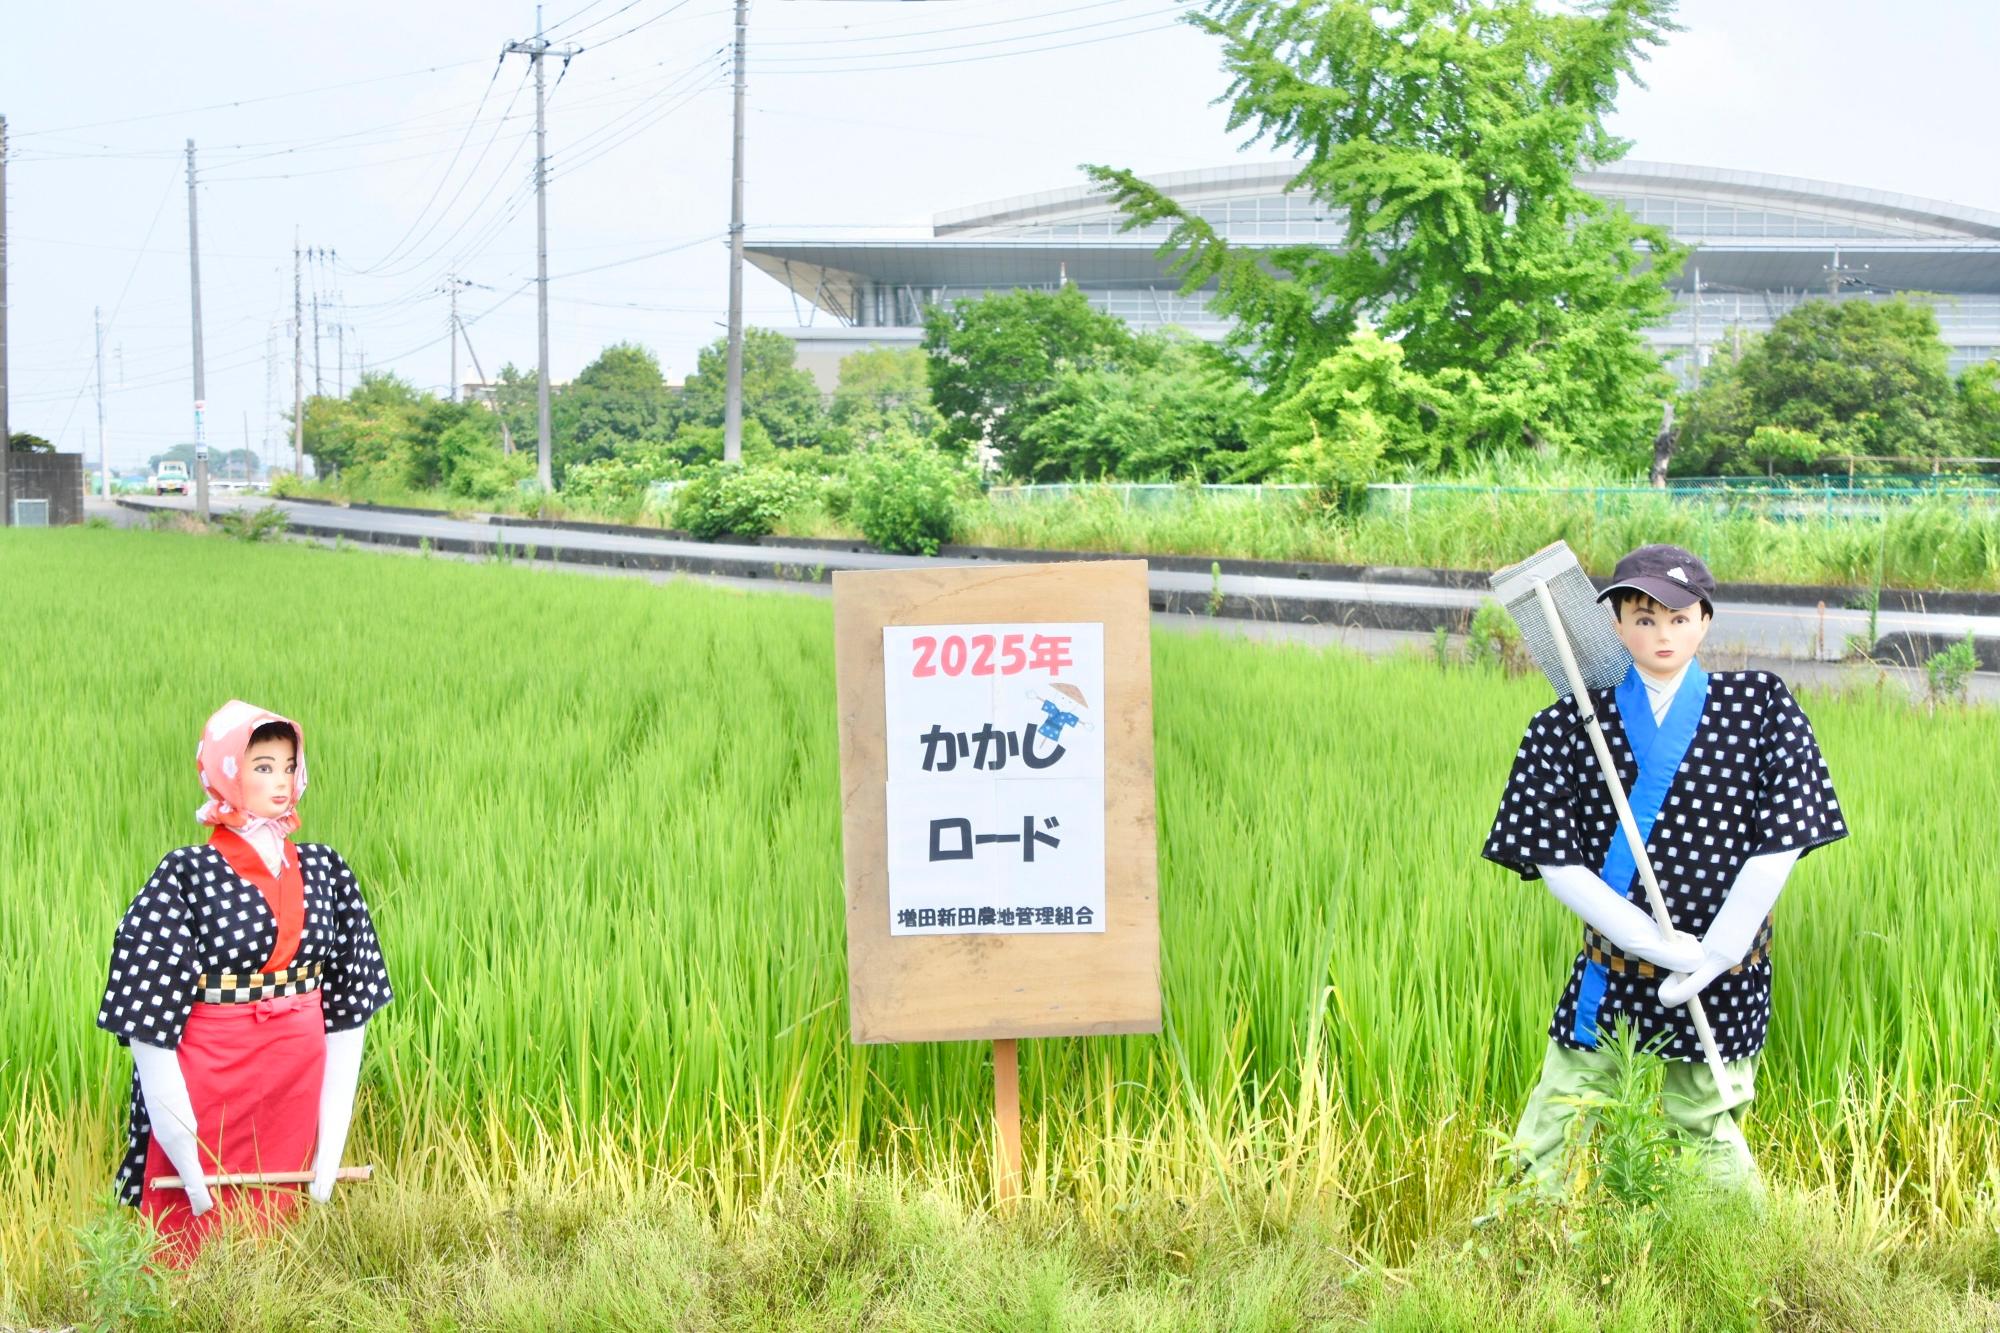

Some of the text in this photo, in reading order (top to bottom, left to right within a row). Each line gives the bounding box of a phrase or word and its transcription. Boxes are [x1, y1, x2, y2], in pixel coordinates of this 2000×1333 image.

[912, 634, 1073, 677] 2025年
[920, 723, 1066, 772] かかし
[929, 815, 1061, 862] ロード
[897, 905, 1095, 928] 増田新田農地管理組合
